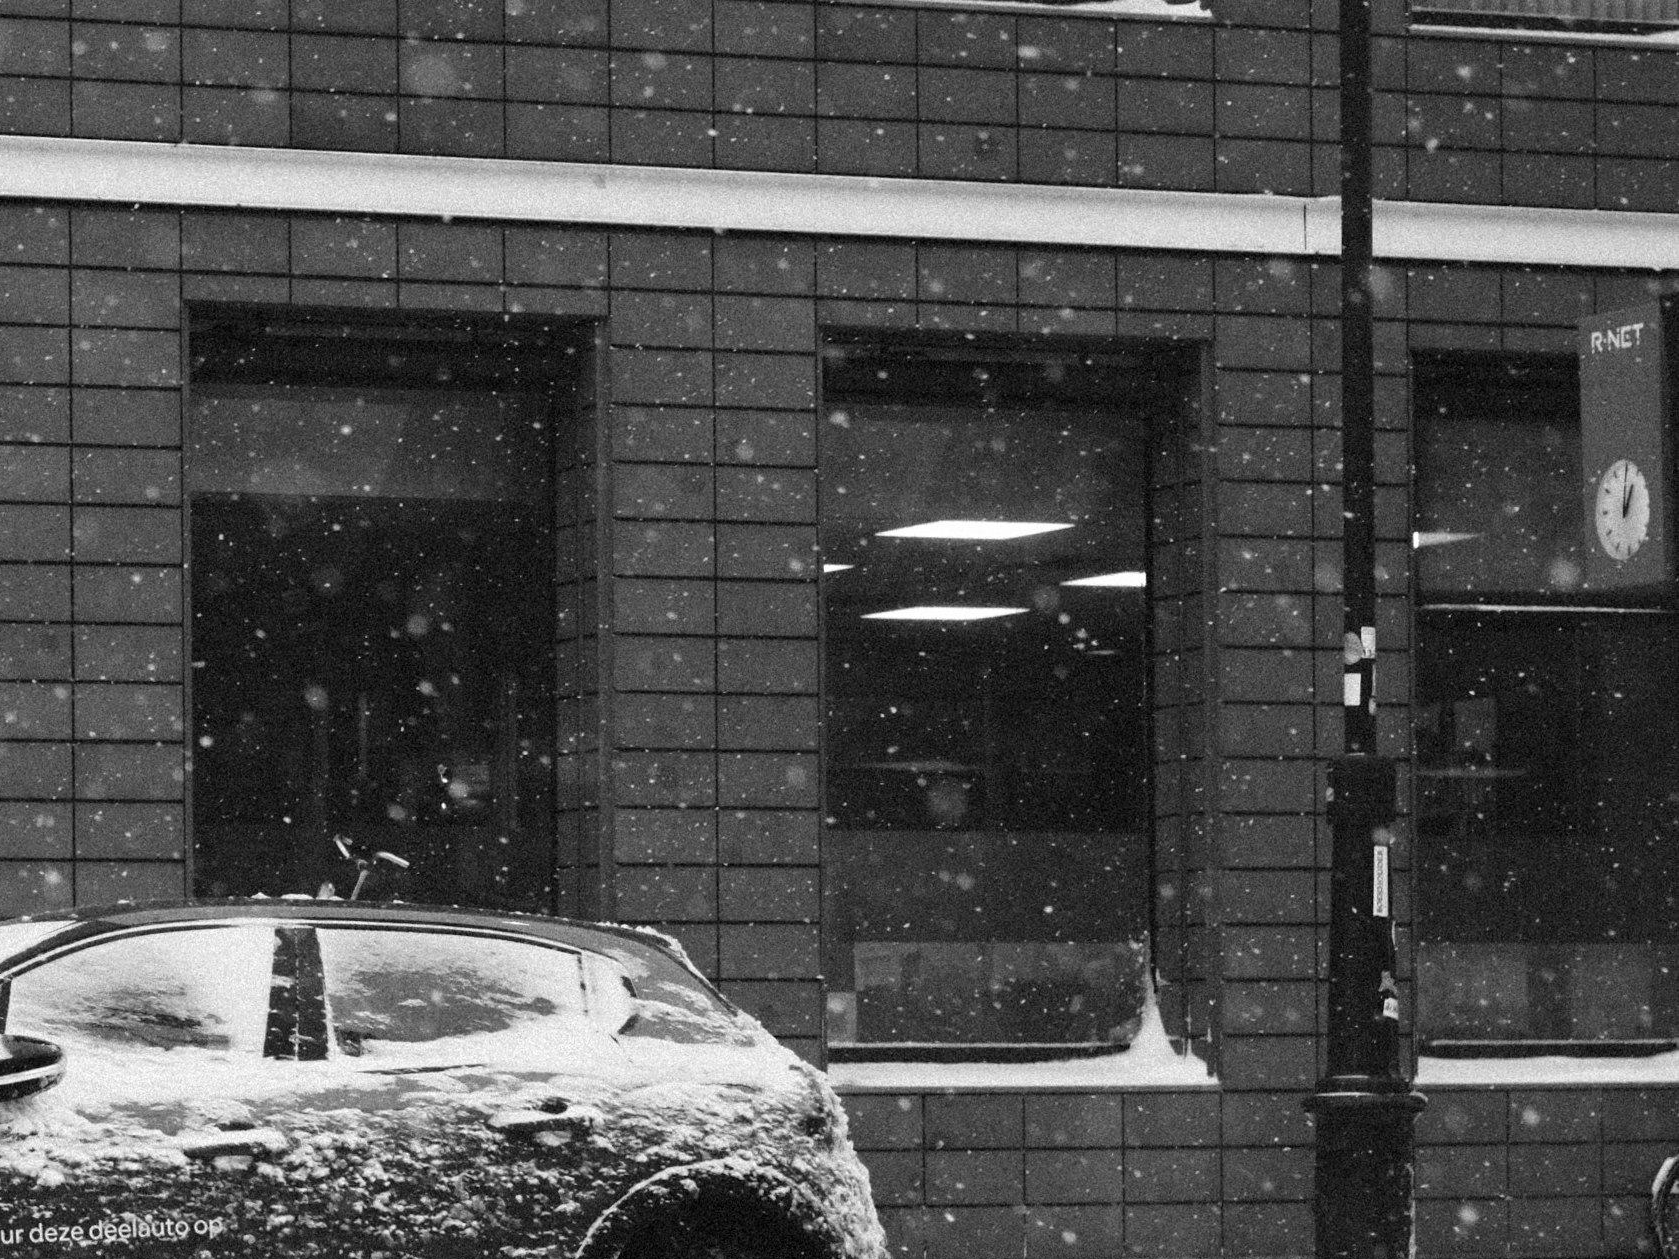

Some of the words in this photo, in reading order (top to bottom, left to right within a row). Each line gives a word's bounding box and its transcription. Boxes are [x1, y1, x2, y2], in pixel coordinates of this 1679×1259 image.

[29, 1222, 84, 1244] deze
[89, 1218, 188, 1241] deelauto
[194, 1216, 224, 1239] op
